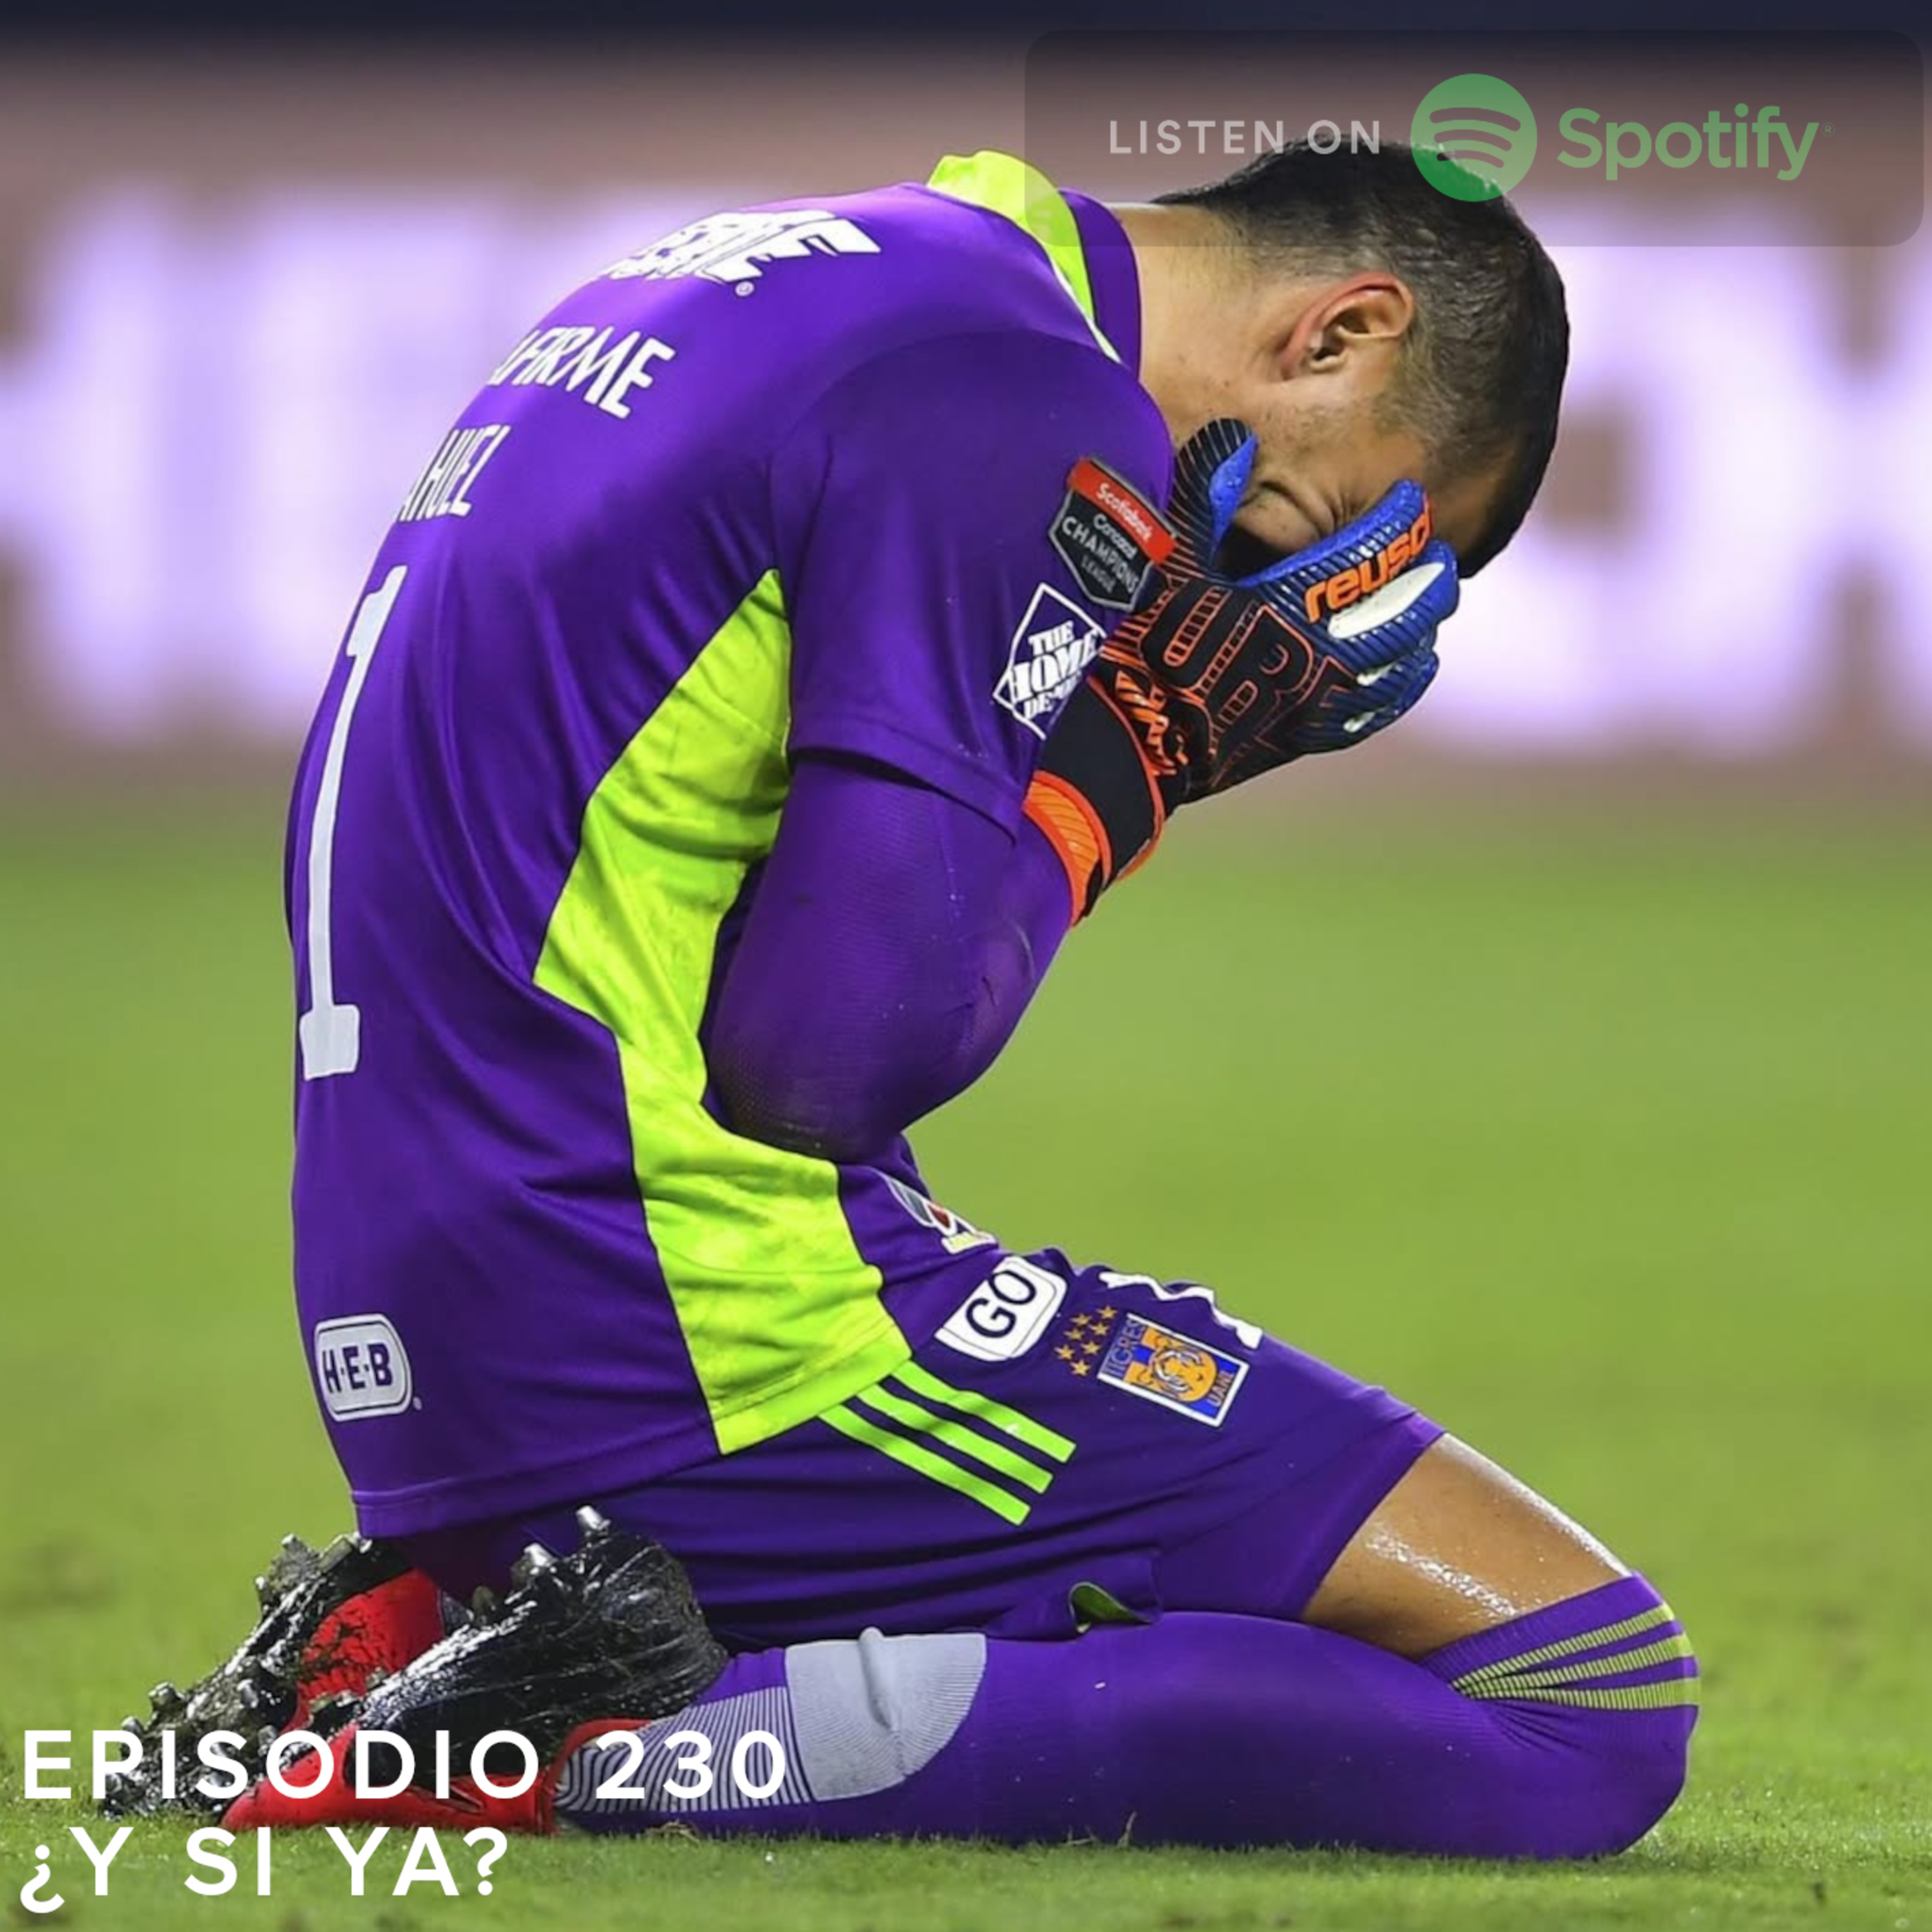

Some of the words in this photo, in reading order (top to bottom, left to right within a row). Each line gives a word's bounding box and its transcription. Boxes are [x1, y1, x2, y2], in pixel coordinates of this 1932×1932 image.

[1063, 516, 1139, 594] CHAMPIONS
[1028, 620, 1075, 656] THE
[299, 565, 407, 1080] 1
[965, 1271, 1037, 1339] GO
[1101, 1319, 1145, 1378] TIGRES
